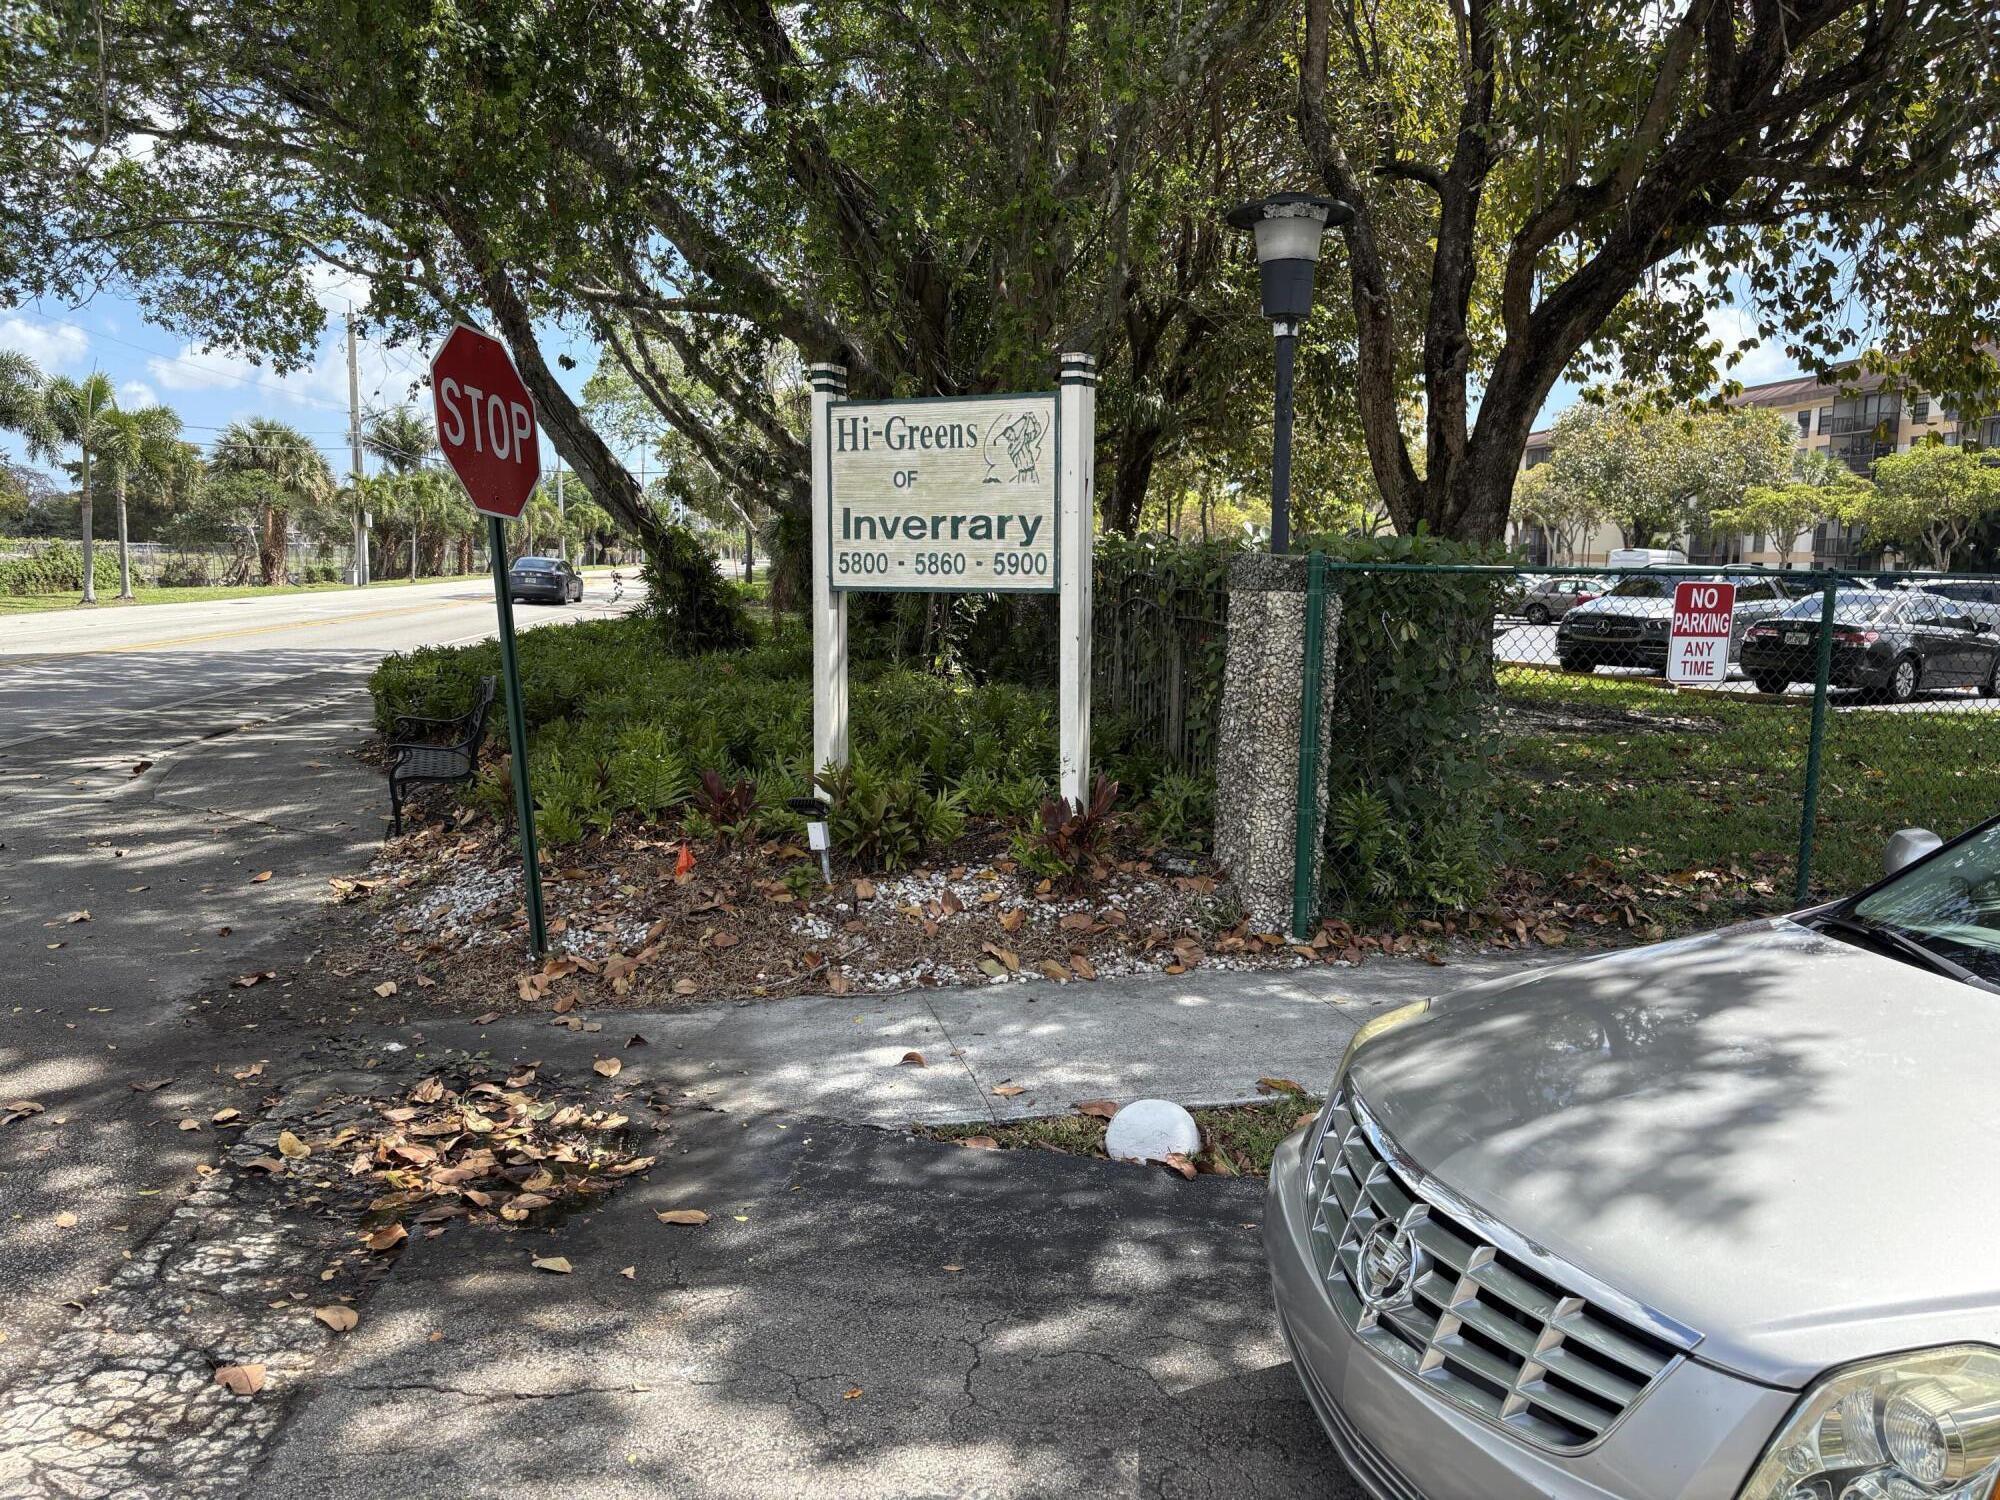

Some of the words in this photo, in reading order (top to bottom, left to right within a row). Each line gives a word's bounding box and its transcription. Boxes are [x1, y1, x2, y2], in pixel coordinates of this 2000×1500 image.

[441, 377, 531, 464] STOP
[836, 415, 978, 451] Hi-Greens
[893, 470, 918, 488] OF
[842, 507, 1043, 547] Inverrary
[838, 552, 888, 574] 5800
[914, 552, 966, 575] 5860
[993, 552, 1047, 575] 5900
[1691, 588, 1718, 608] NO
[1673, 612, 1729, 633] PARKING
[1683, 641, 1714, 656] ANY
[1681, 660, 1714, 676] TIME
